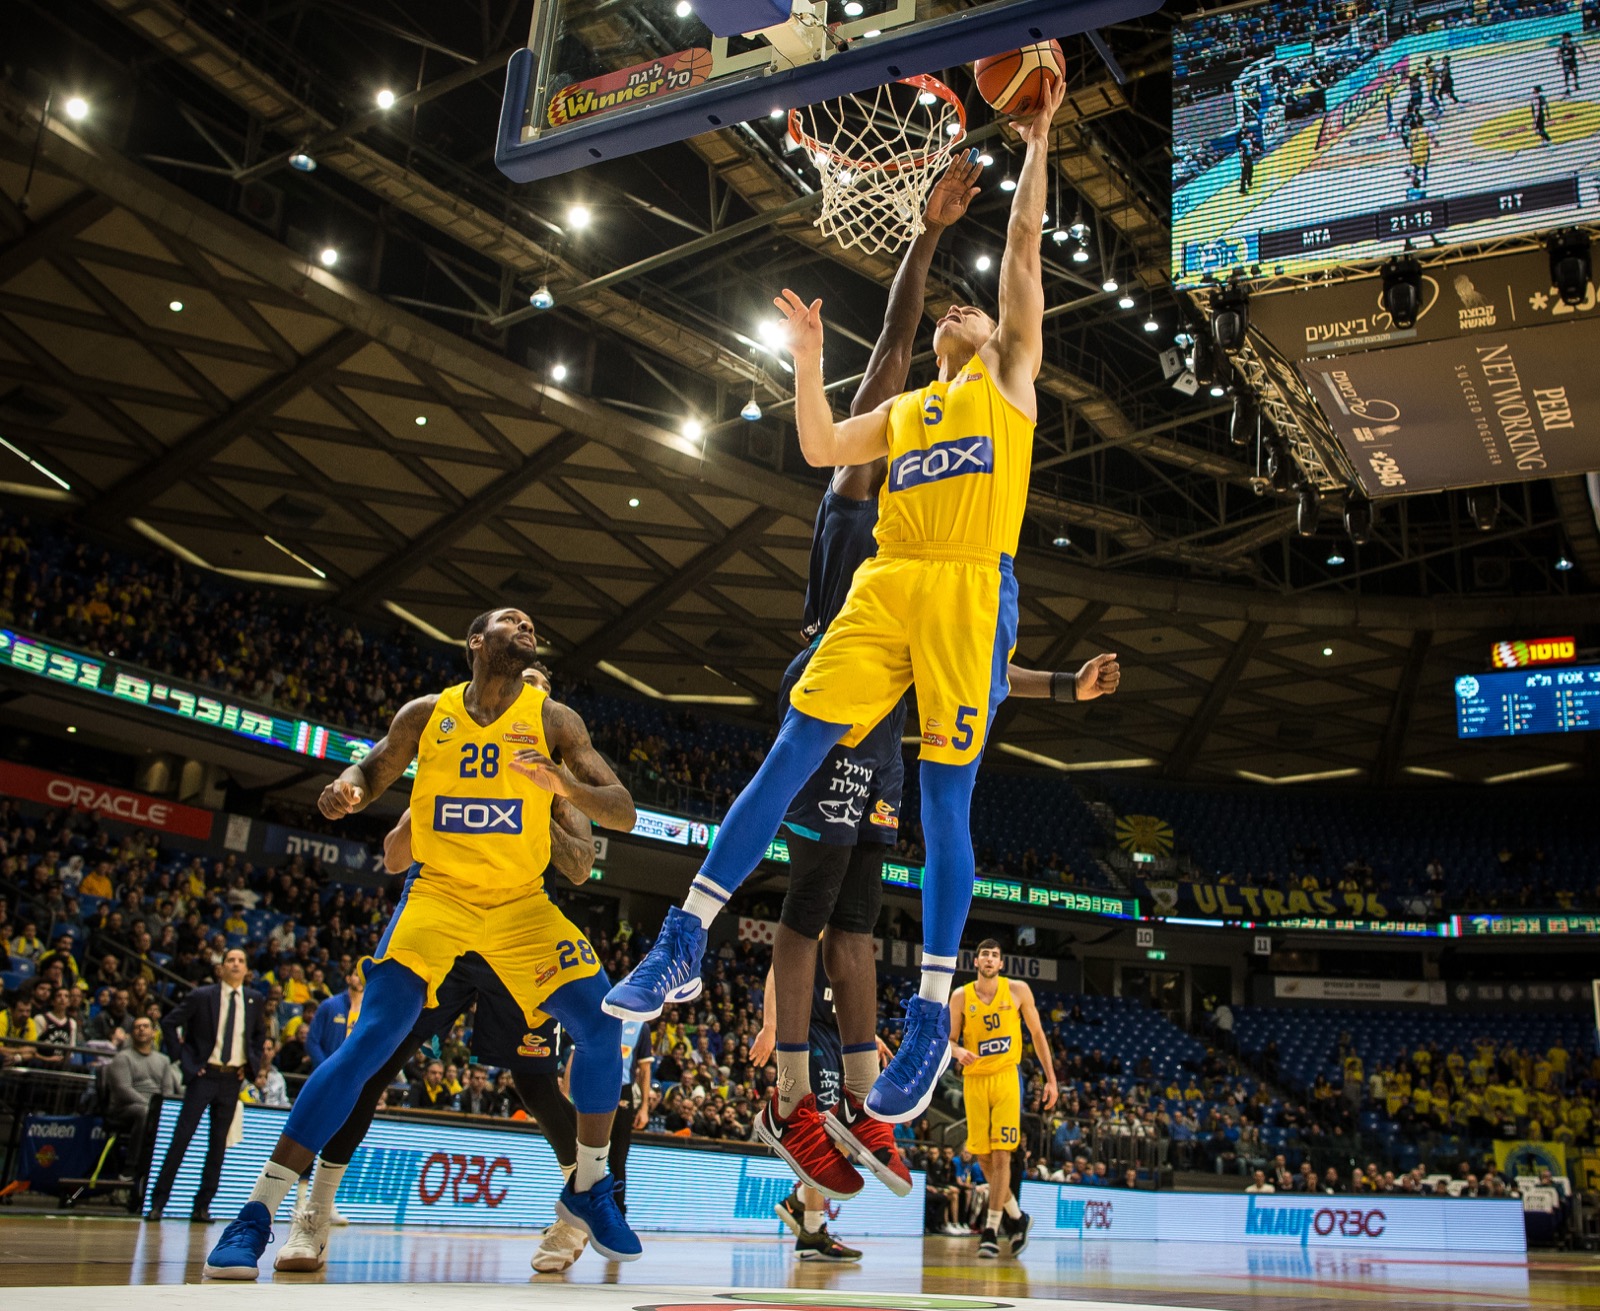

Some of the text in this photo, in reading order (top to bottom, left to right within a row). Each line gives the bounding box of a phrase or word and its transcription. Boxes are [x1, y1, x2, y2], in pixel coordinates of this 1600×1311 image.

[628, 63, 663, 87] ליגת
[667, 71, 690, 88] סל
[566, 78, 665, 117] Winner
[1458, 305, 1495, 319] קבוצת
[1459, 315, 1497, 330] שאשא
[1305, 318, 1369, 342] ביצועים
[1454, 364, 1482, 414] SUCCEED
[1476, 344, 1547, 471] NETWORKING
[1533, 386, 1575, 431] PERI
[1475, 416, 1502, 466] TOGETHER
[896, 442, 985, 486] FOX
[1529, 642, 1575, 661] טוטו
[113, 672, 273, 738] מוכרים
[951, 705, 978, 751] 5
[459, 743, 500, 779] 28
[829, 776, 871, 799] אילת
[47, 780, 169, 826] ORACLE
[441, 803, 518, 829] FOX
[285, 835, 340, 865] מדיה
[1029, 887, 1123, 915] מוכרים
[1192, 882, 1389, 919] ULTRAS 96
[1137, 931, 1153, 945] 10
[1256, 939, 1269, 953] 11
[556, 939, 597, 971] 28
[983, 1013, 1001, 1031] 50
[979, 1037, 1011, 1055] FOX
[27, 1122, 76, 1139] molten
[1000, 1126, 1018, 1144] 50
